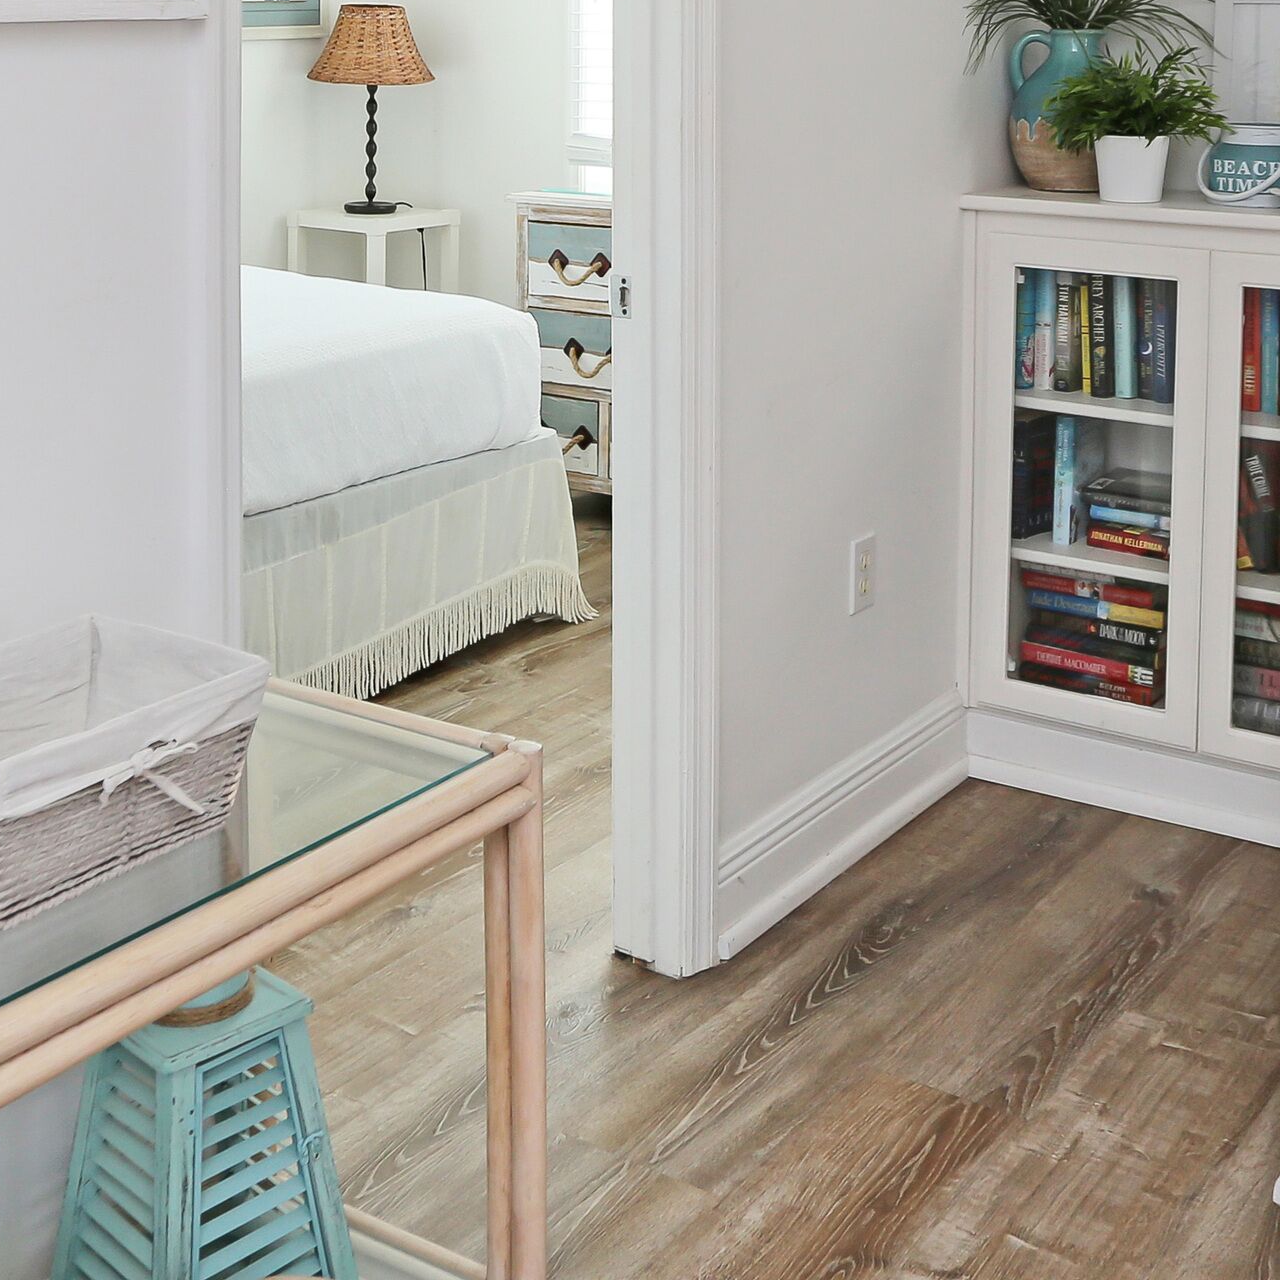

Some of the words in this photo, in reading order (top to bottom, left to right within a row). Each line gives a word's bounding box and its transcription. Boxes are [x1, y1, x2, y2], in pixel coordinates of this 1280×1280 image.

[1057, 304, 1070, 347] HANNAH
[1091, 305, 1106, 343] ARCHER
[1245, 455, 1264, 476] TRUE
[1090, 530, 1123, 544] JONATHAN
[1123, 536, 1163, 552] KELLERMAN
[1099, 623, 1119, 641] DARK
[1124, 628, 1147, 646] MOON
